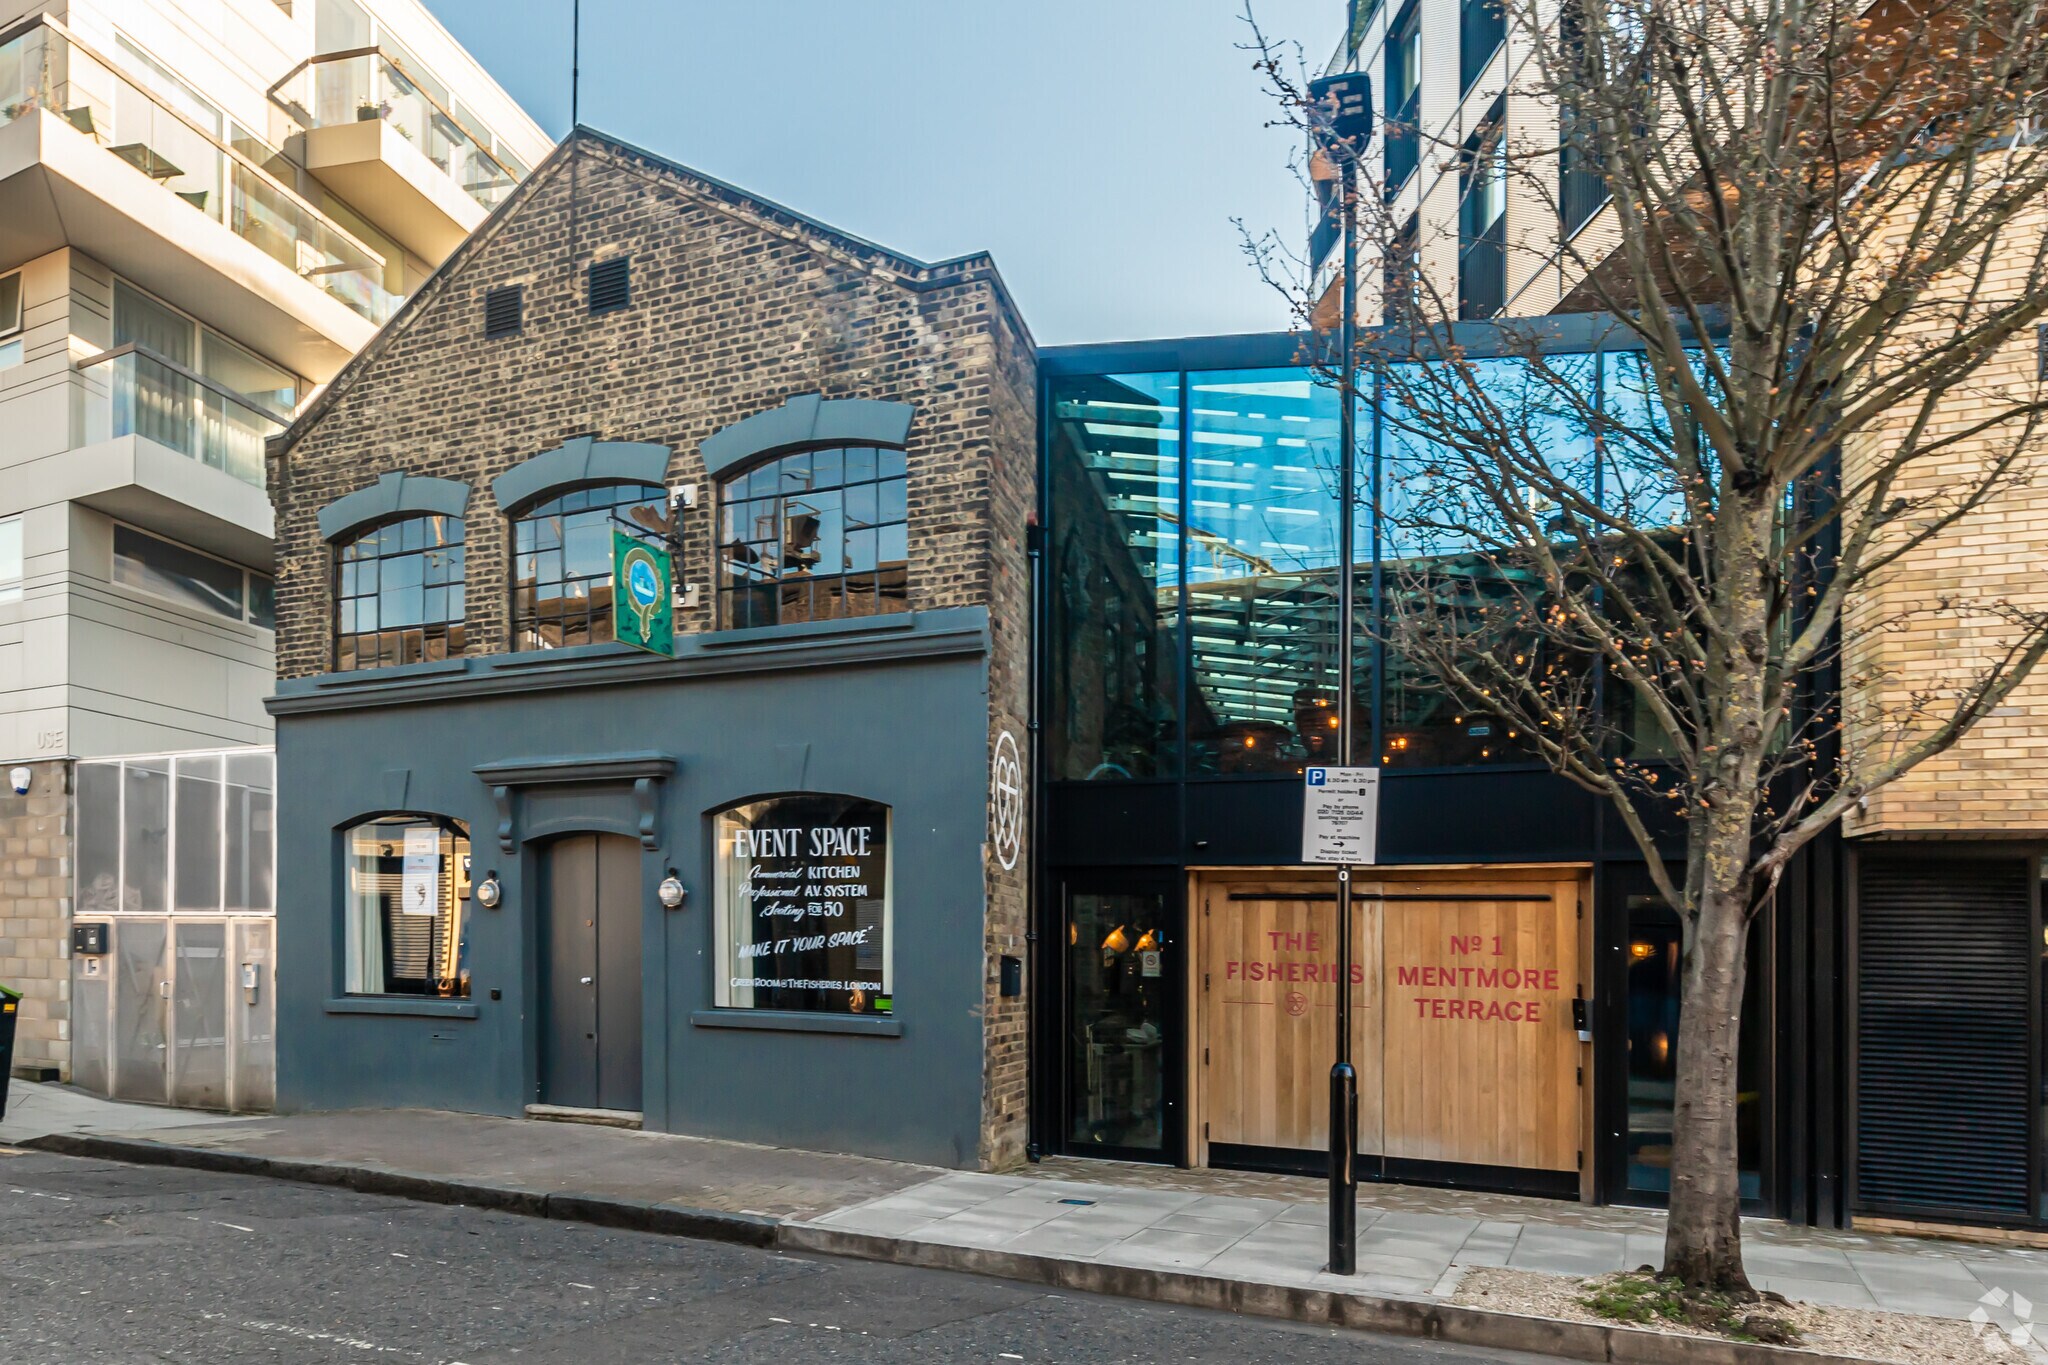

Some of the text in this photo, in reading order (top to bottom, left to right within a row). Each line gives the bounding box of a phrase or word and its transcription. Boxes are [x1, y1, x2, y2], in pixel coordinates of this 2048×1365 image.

[38, 730, 64, 750] USE
[1312, 770, 1323, 784] P
[735, 826, 872, 858] EVENT SPACE
[747, 864, 860, 879] Commercial KITCHEN
[738, 882, 801, 901] Professional
[824, 885, 868, 897] SYSTEM
[760, 901, 844, 922] Seating FOR 50
[774, 939, 790, 954] IT
[792, 935, 825, 952] YOUR
[1268, 932, 1320, 951] THE
[1491, 936, 1504, 956] 1
[1398, 966, 1559, 990] MENTMORE
[1414, 998, 1541, 1022] TERRACE
